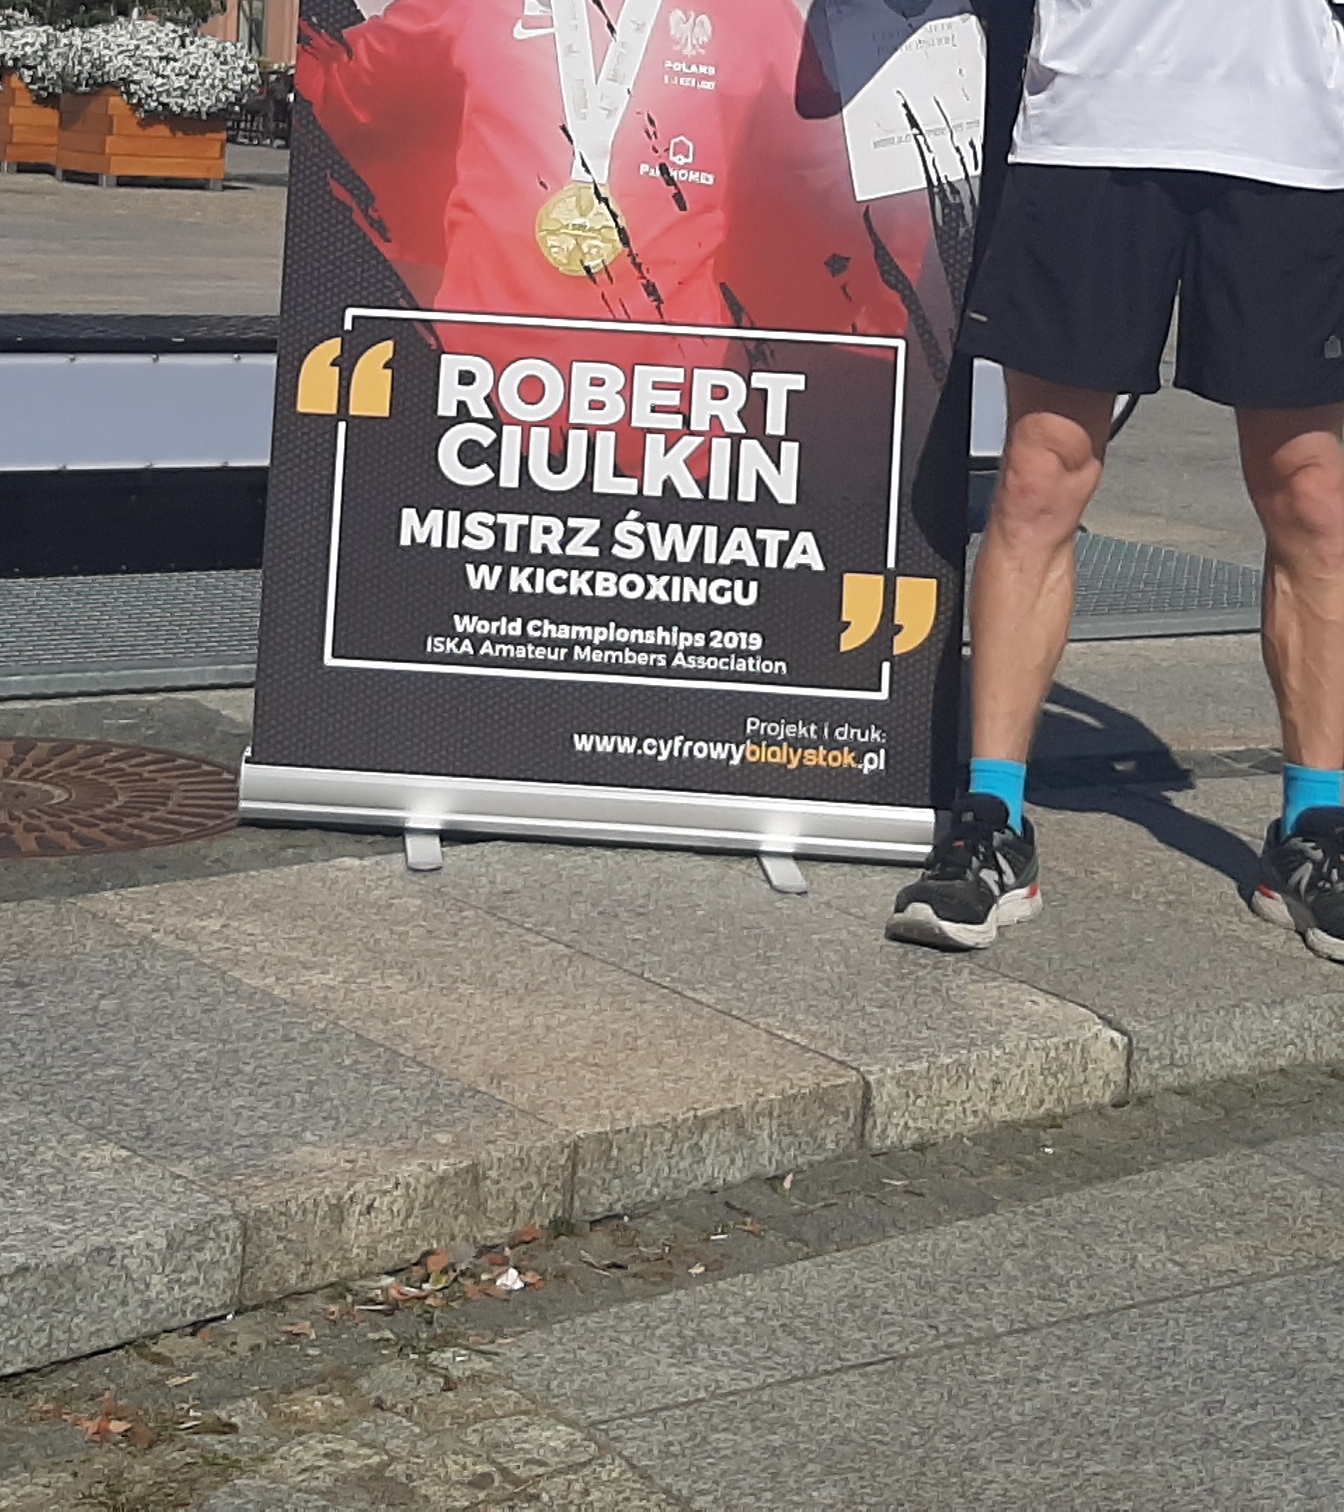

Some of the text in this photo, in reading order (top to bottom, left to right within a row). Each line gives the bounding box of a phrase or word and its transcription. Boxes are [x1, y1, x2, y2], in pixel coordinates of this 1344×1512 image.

[436, 353, 806, 436] ROBERT
[437, 421, 800, 505] CIULKIN
[398, 507, 826, 572] MISTRZ ŚWIATA
[465, 563, 759, 606] W KICKBOXINGU
[453, 614, 763, 651] World Championships 2019
[426, 635, 788, 675] ISKA Amateur Members Association
[746, 717, 887, 743] Projekt i druk:
[573, 733, 886, 775] www.cyfrowybialystok.pl
